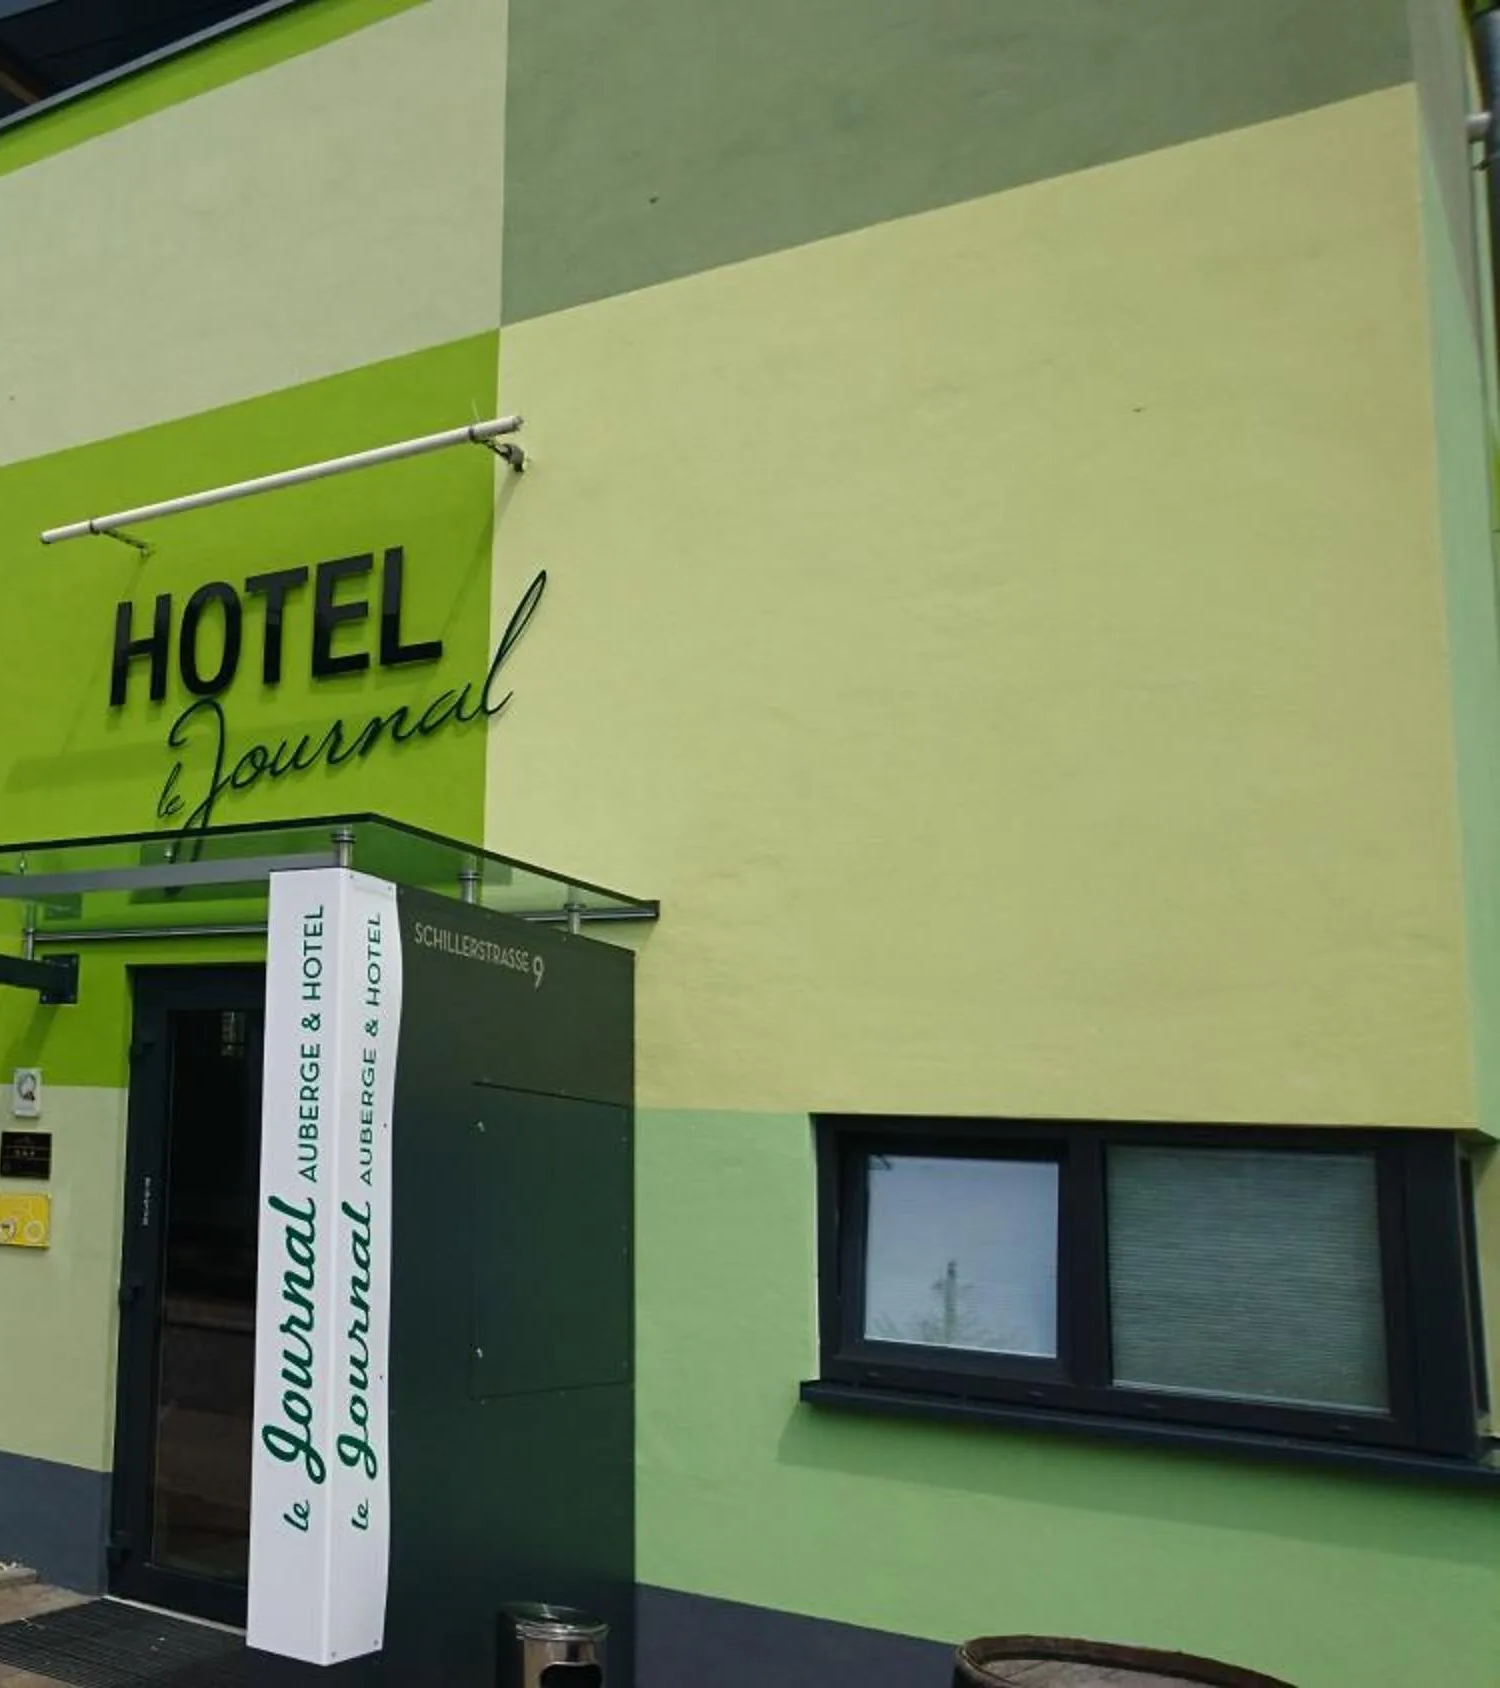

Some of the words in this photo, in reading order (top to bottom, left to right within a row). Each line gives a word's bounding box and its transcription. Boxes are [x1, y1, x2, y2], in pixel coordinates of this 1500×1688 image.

[108, 545, 442, 707] HOTEL
[168, 569, 548, 877] Journal
[302, 904, 324, 1001] HOTEL
[365, 912, 382, 1006] HOTEL
[414, 922, 531, 973] SCHILLERSTRASSE
[533, 955, 545, 989] 9
[301, 1012, 323, 1031] &
[364, 1019, 380, 1037] &
[297, 1042, 322, 1183] AUBERGE
[359, 1047, 378, 1186] AUBERGE
[262, 1194, 327, 1485] Journal
[336, 1200, 378, 1480] Journal
[283, 1500, 310, 1532] le
[351, 1499, 370, 1531] le
